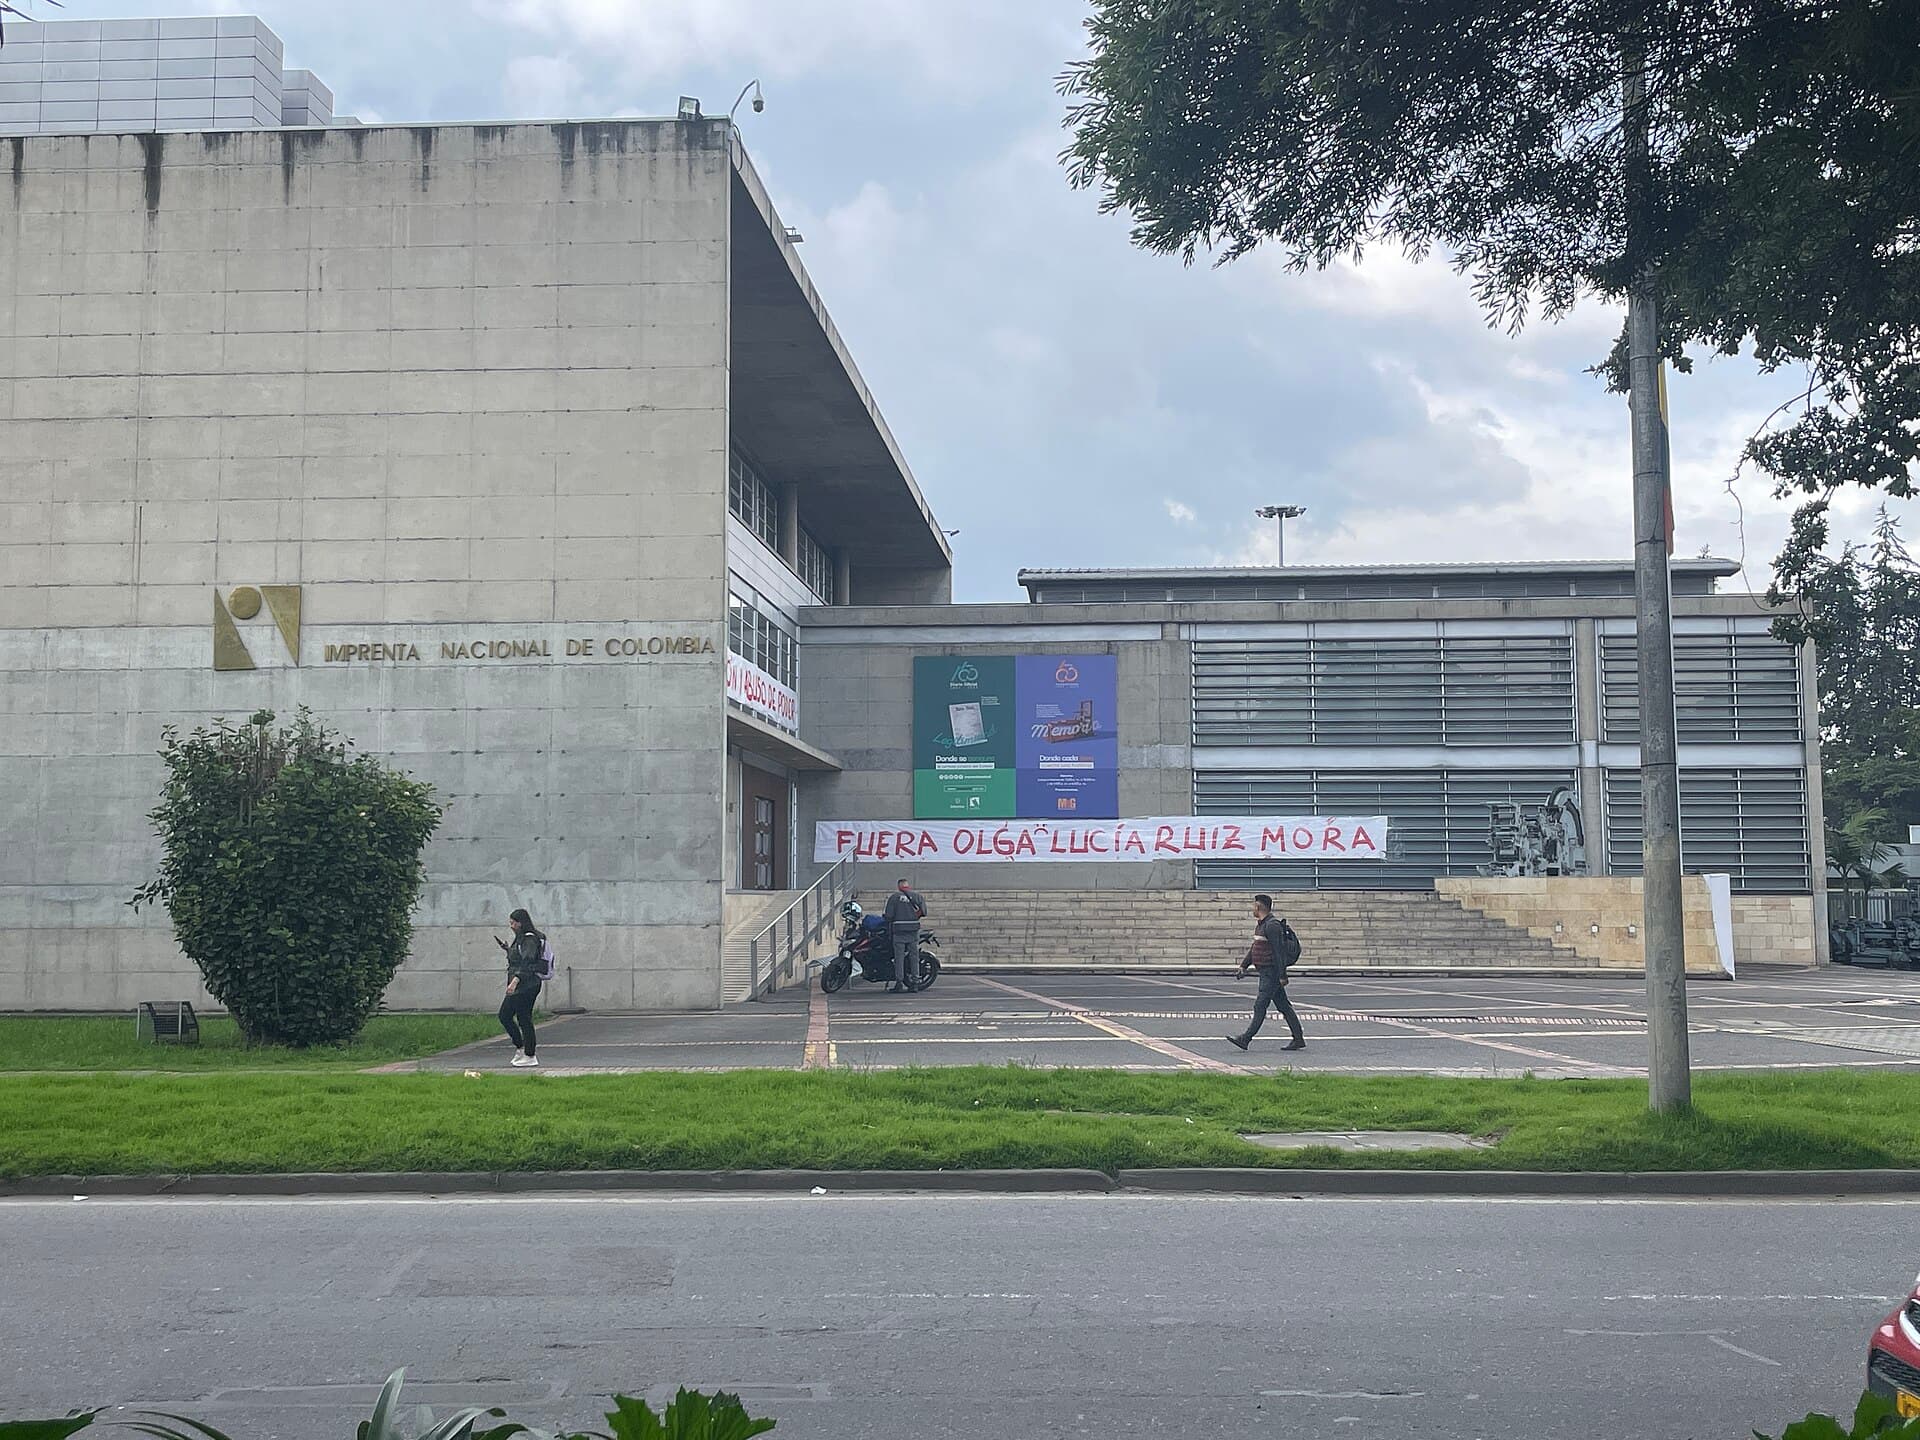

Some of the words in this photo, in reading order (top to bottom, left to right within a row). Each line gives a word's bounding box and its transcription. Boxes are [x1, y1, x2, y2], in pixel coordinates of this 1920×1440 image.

[324, 643, 420, 662] IMPRENTA
[441, 640, 552, 659] NACIONAL
[566, 638, 594, 656] DE
[605, 636, 715, 656] COLOMBIA
[836, 830, 938, 857] FUERA
[954, 828, 1036, 856] OLGA
[1050, 824, 1145, 854] LUCÍA
[1154, 825, 1245, 853] RUIZ
[1261, 825, 1376, 852] MORA
